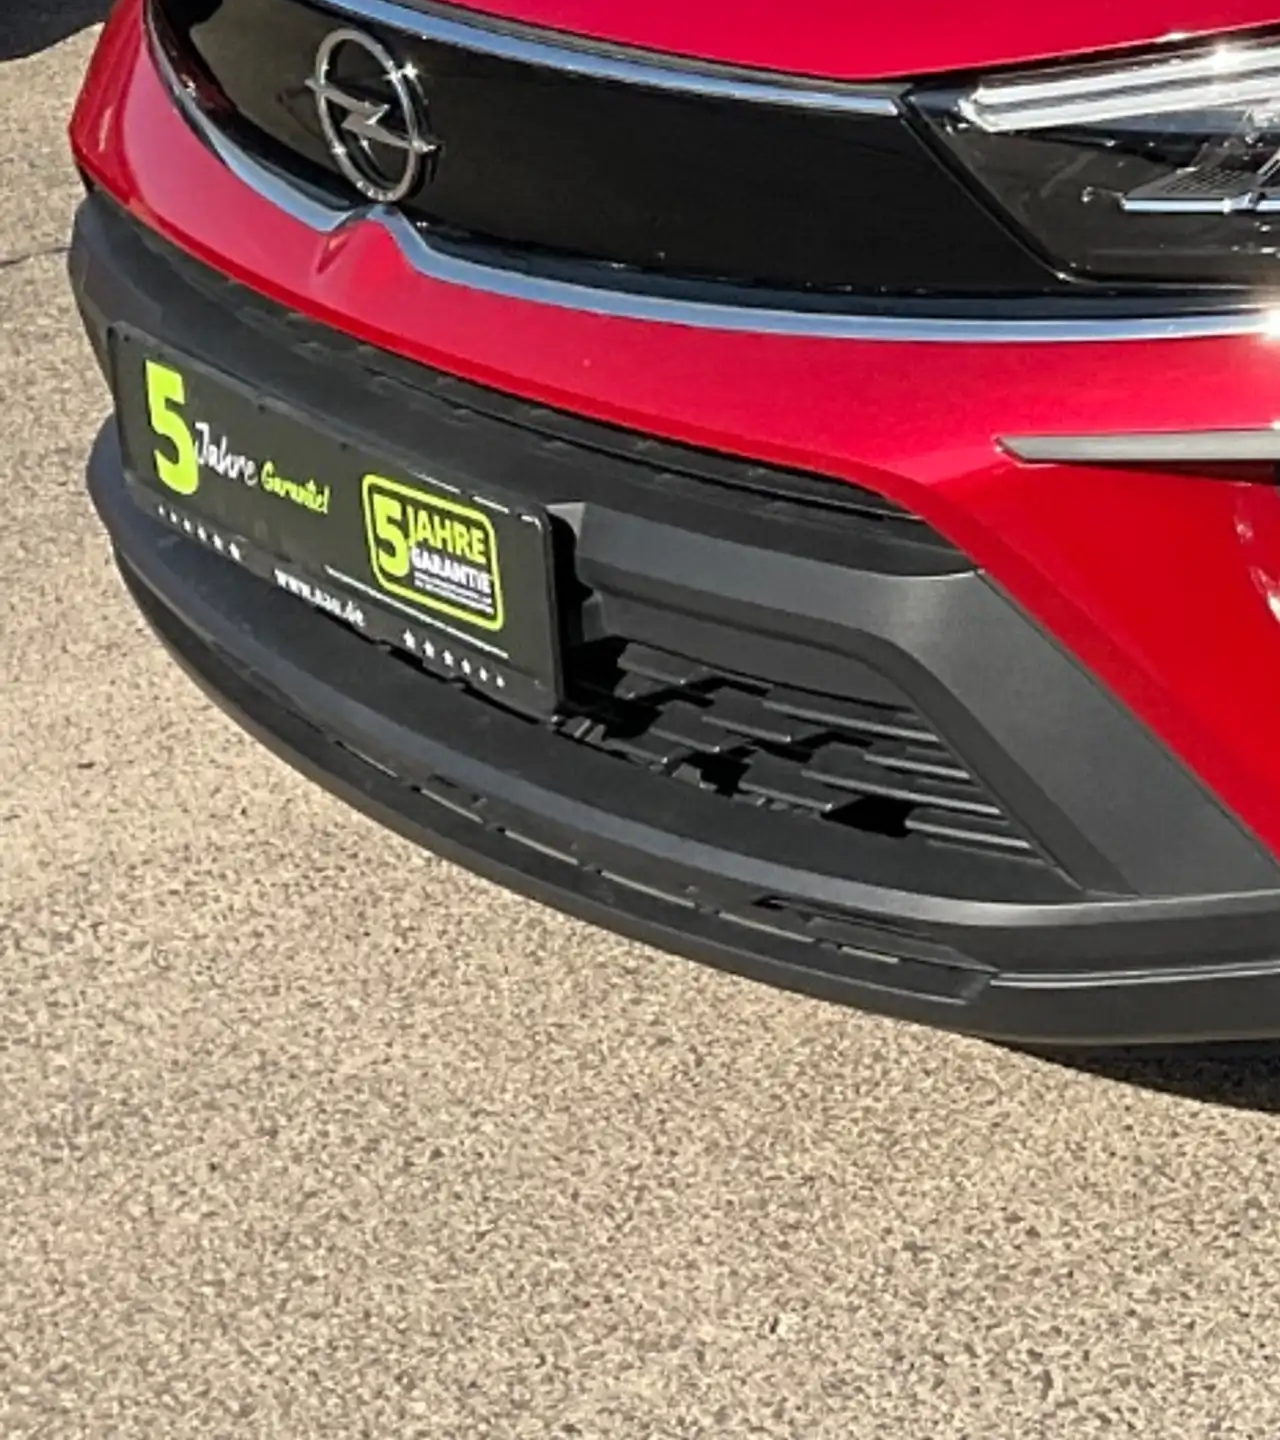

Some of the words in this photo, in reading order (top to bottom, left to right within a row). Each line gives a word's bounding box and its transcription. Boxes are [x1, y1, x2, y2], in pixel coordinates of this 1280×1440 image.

[146, 359, 198, 494] 5
[194, 421, 258, 486] Jahre
[373, 492, 411, 578] 5
[405, 505, 488, 565] JAHRE
[411, 544, 494, 595] GARANTIE
